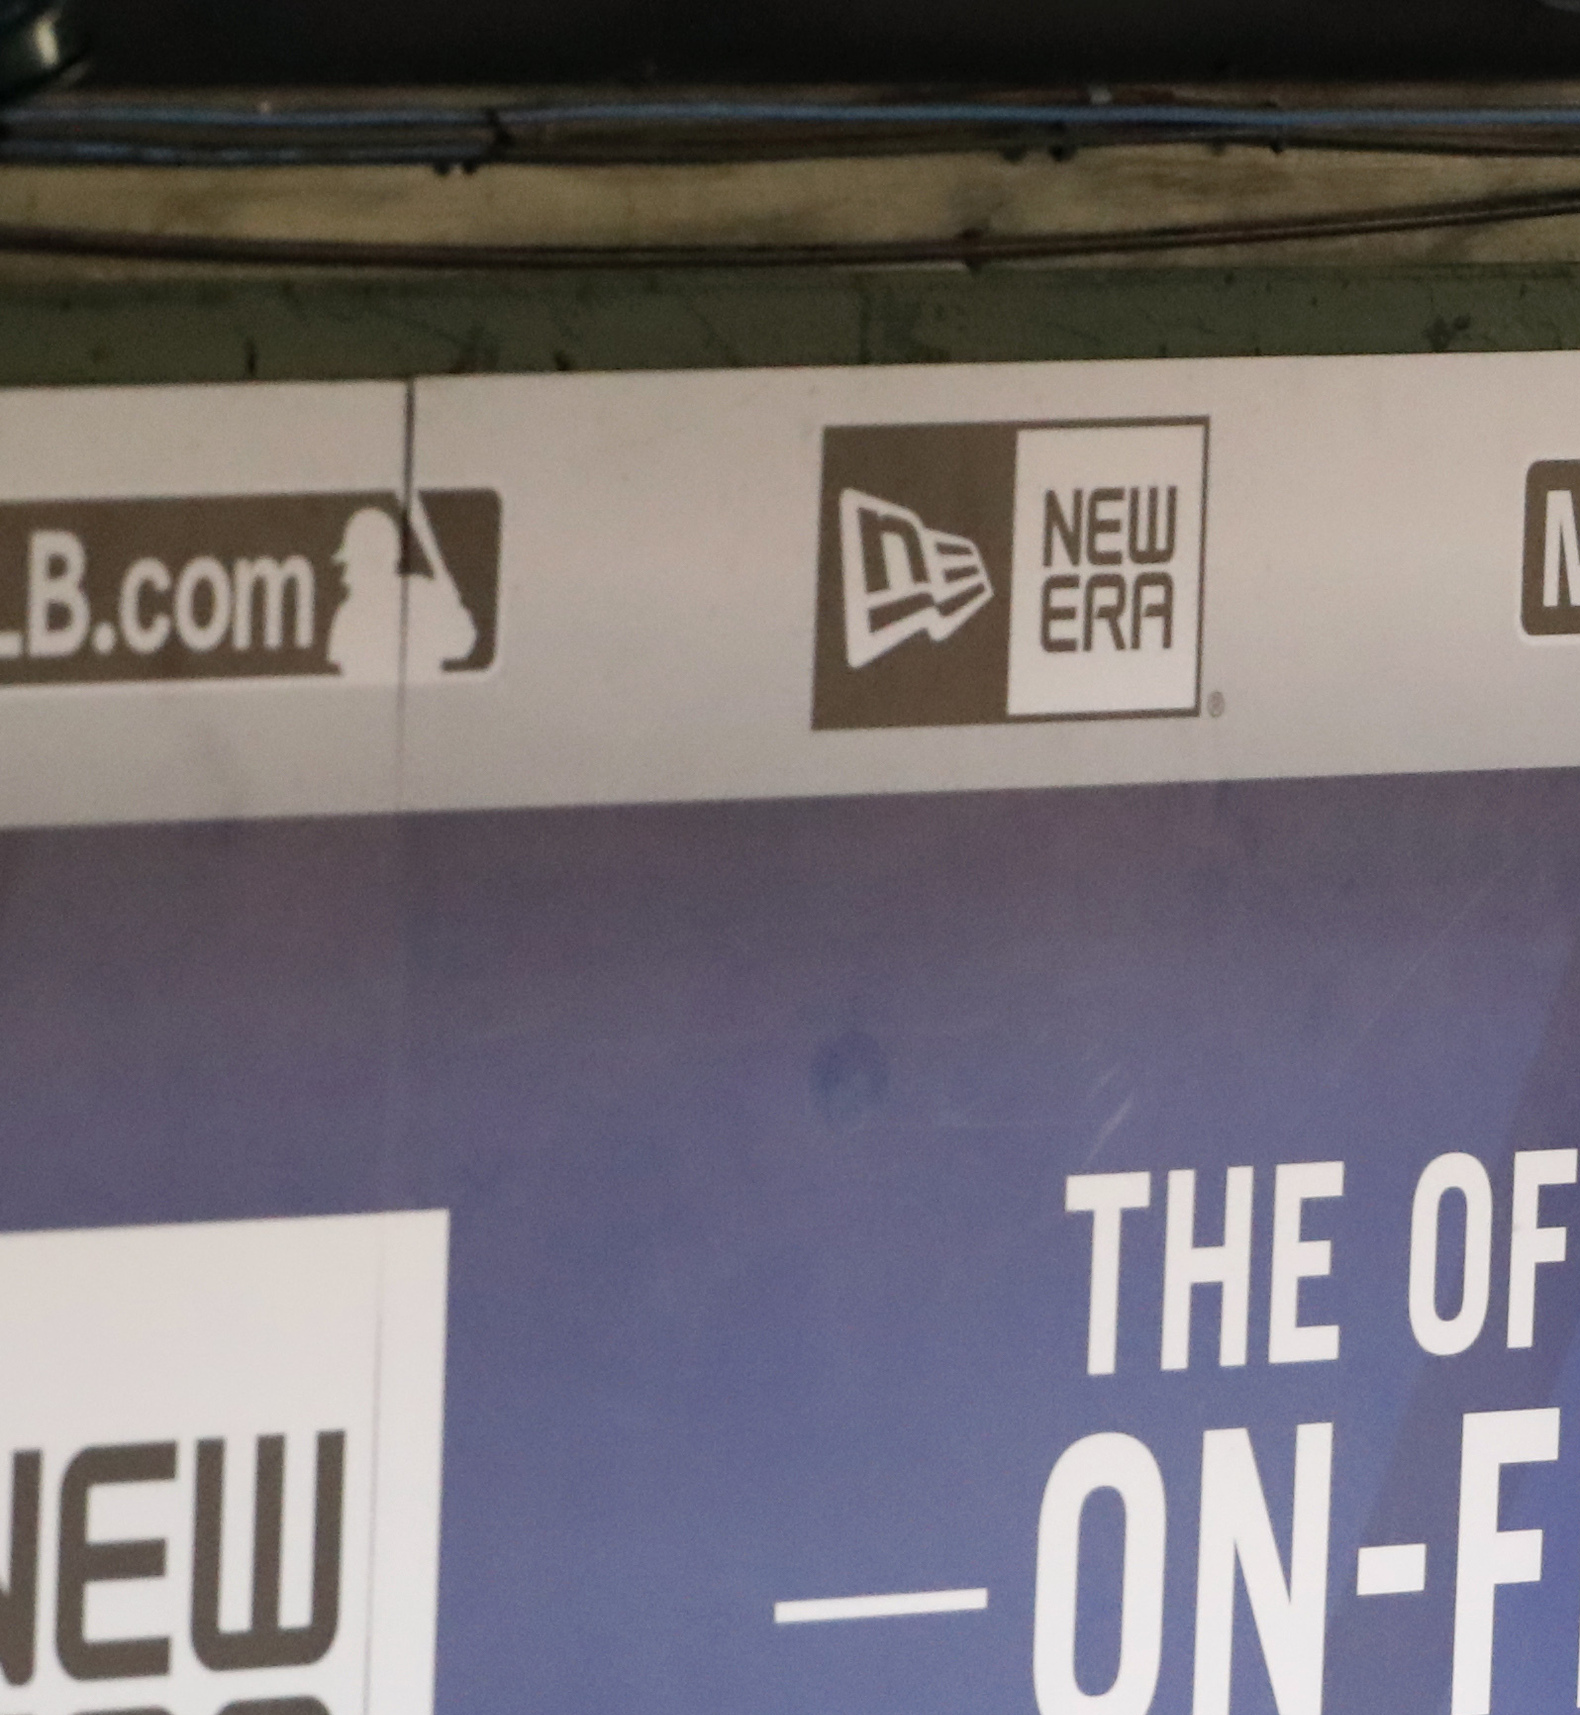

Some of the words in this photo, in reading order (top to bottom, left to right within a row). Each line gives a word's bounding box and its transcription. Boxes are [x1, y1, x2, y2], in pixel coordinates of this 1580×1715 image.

[1043, 486, 1177, 567] NEW
[0, 530, 315, 659] B.com
[1040, 573, 1173, 653] ERA
[1064, 1160, 1346, 1376] THE
